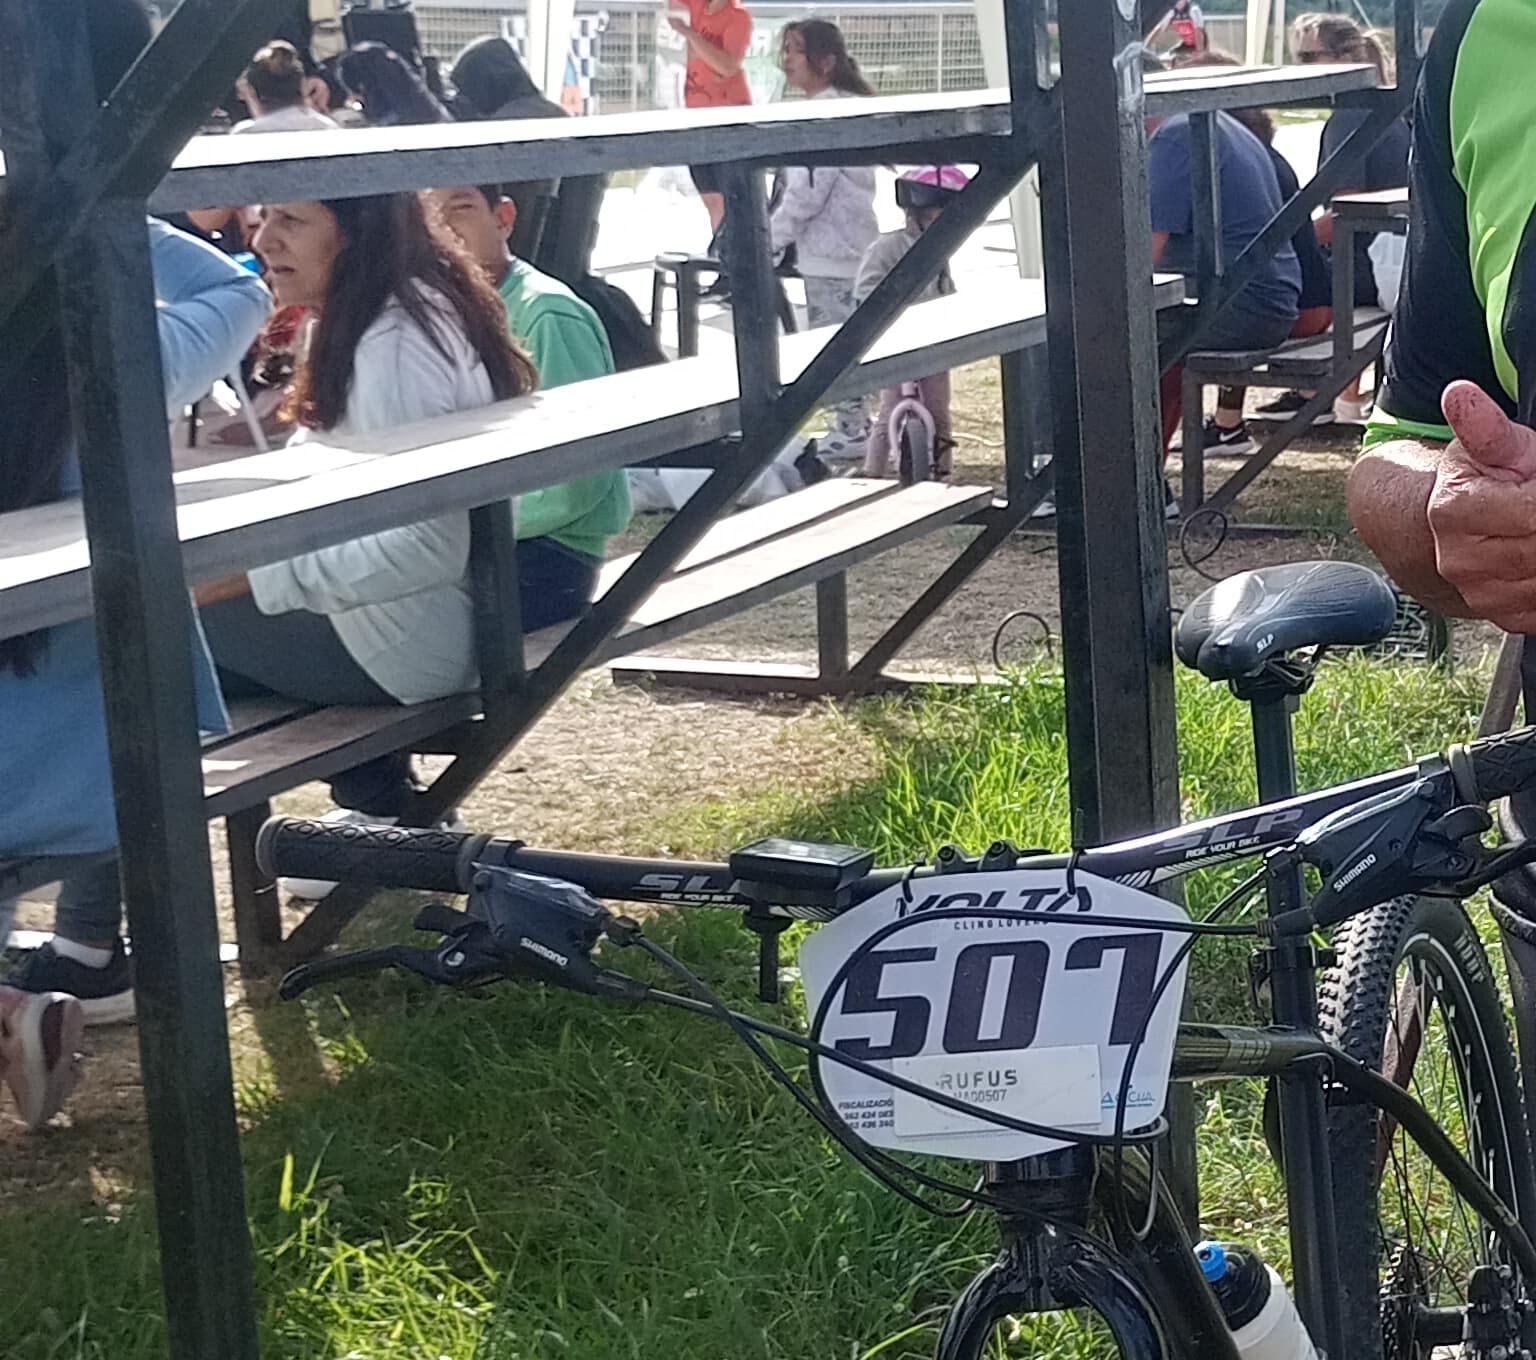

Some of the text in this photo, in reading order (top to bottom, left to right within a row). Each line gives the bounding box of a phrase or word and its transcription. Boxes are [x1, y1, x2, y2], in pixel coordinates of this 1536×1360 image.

[1256, 633, 1275, 654] SLP
[1154, 808, 1305, 856] SLP
[1210, 840, 1237, 854] YOUR
[1238, 835, 1262, 848] BIKE
[1332, 852, 1377, 893] SHIMANO
[520, 936, 569, 967] SHIMANO
[833, 931, 1165, 1061] 507
[938, 1069, 1019, 1090] RUFUS
